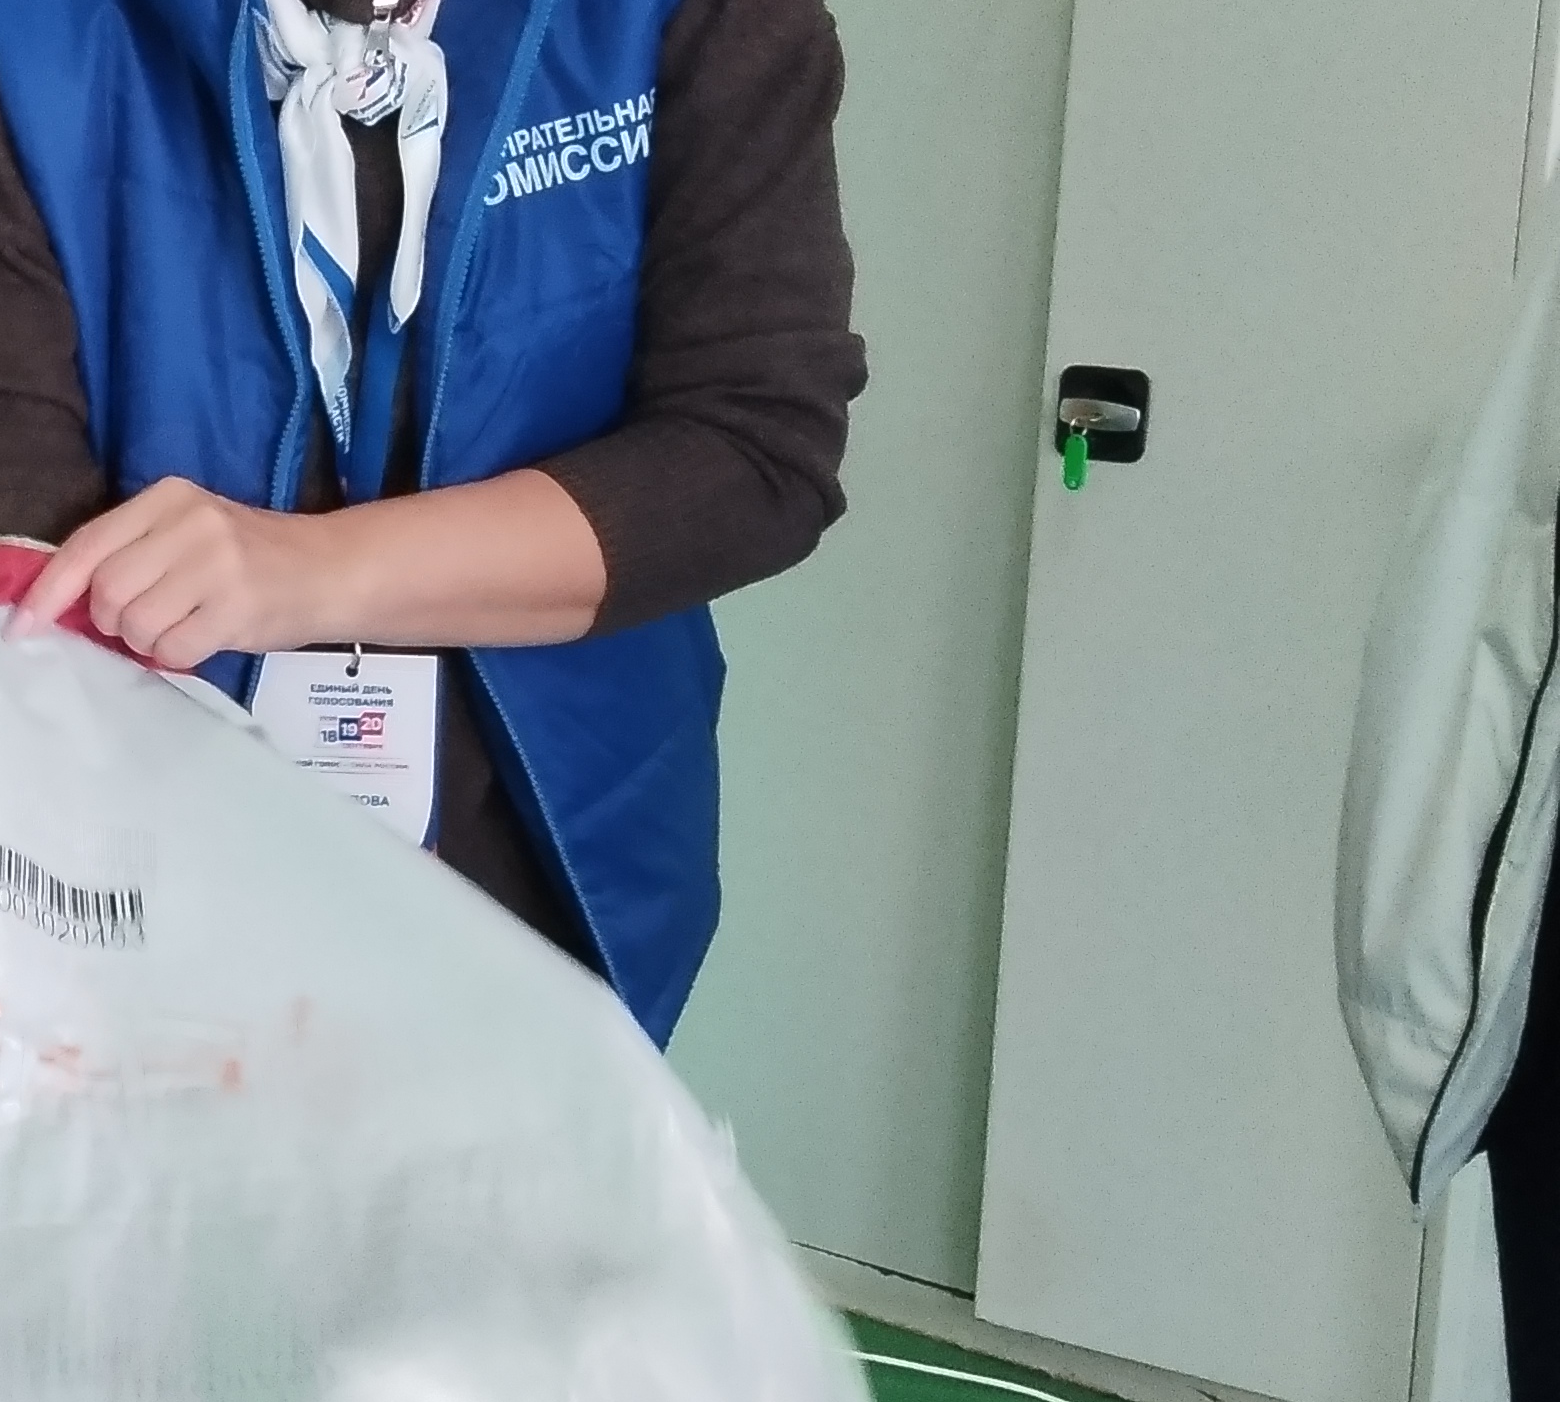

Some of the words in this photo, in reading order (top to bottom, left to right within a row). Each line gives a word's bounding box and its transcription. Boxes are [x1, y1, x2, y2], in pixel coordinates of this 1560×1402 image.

[483, 123, 652, 206] ОМИССИ
[310, 682, 359, 694] ЕДИНЫЙ
[362, 685, 393, 695] ДЕНЬ
[308, 696, 394, 707] ГОЛОСОВАНИЯ
[320, 729, 338, 743] 18
[340, 722, 358, 737] 19
[360, 717, 382, 731] 20
